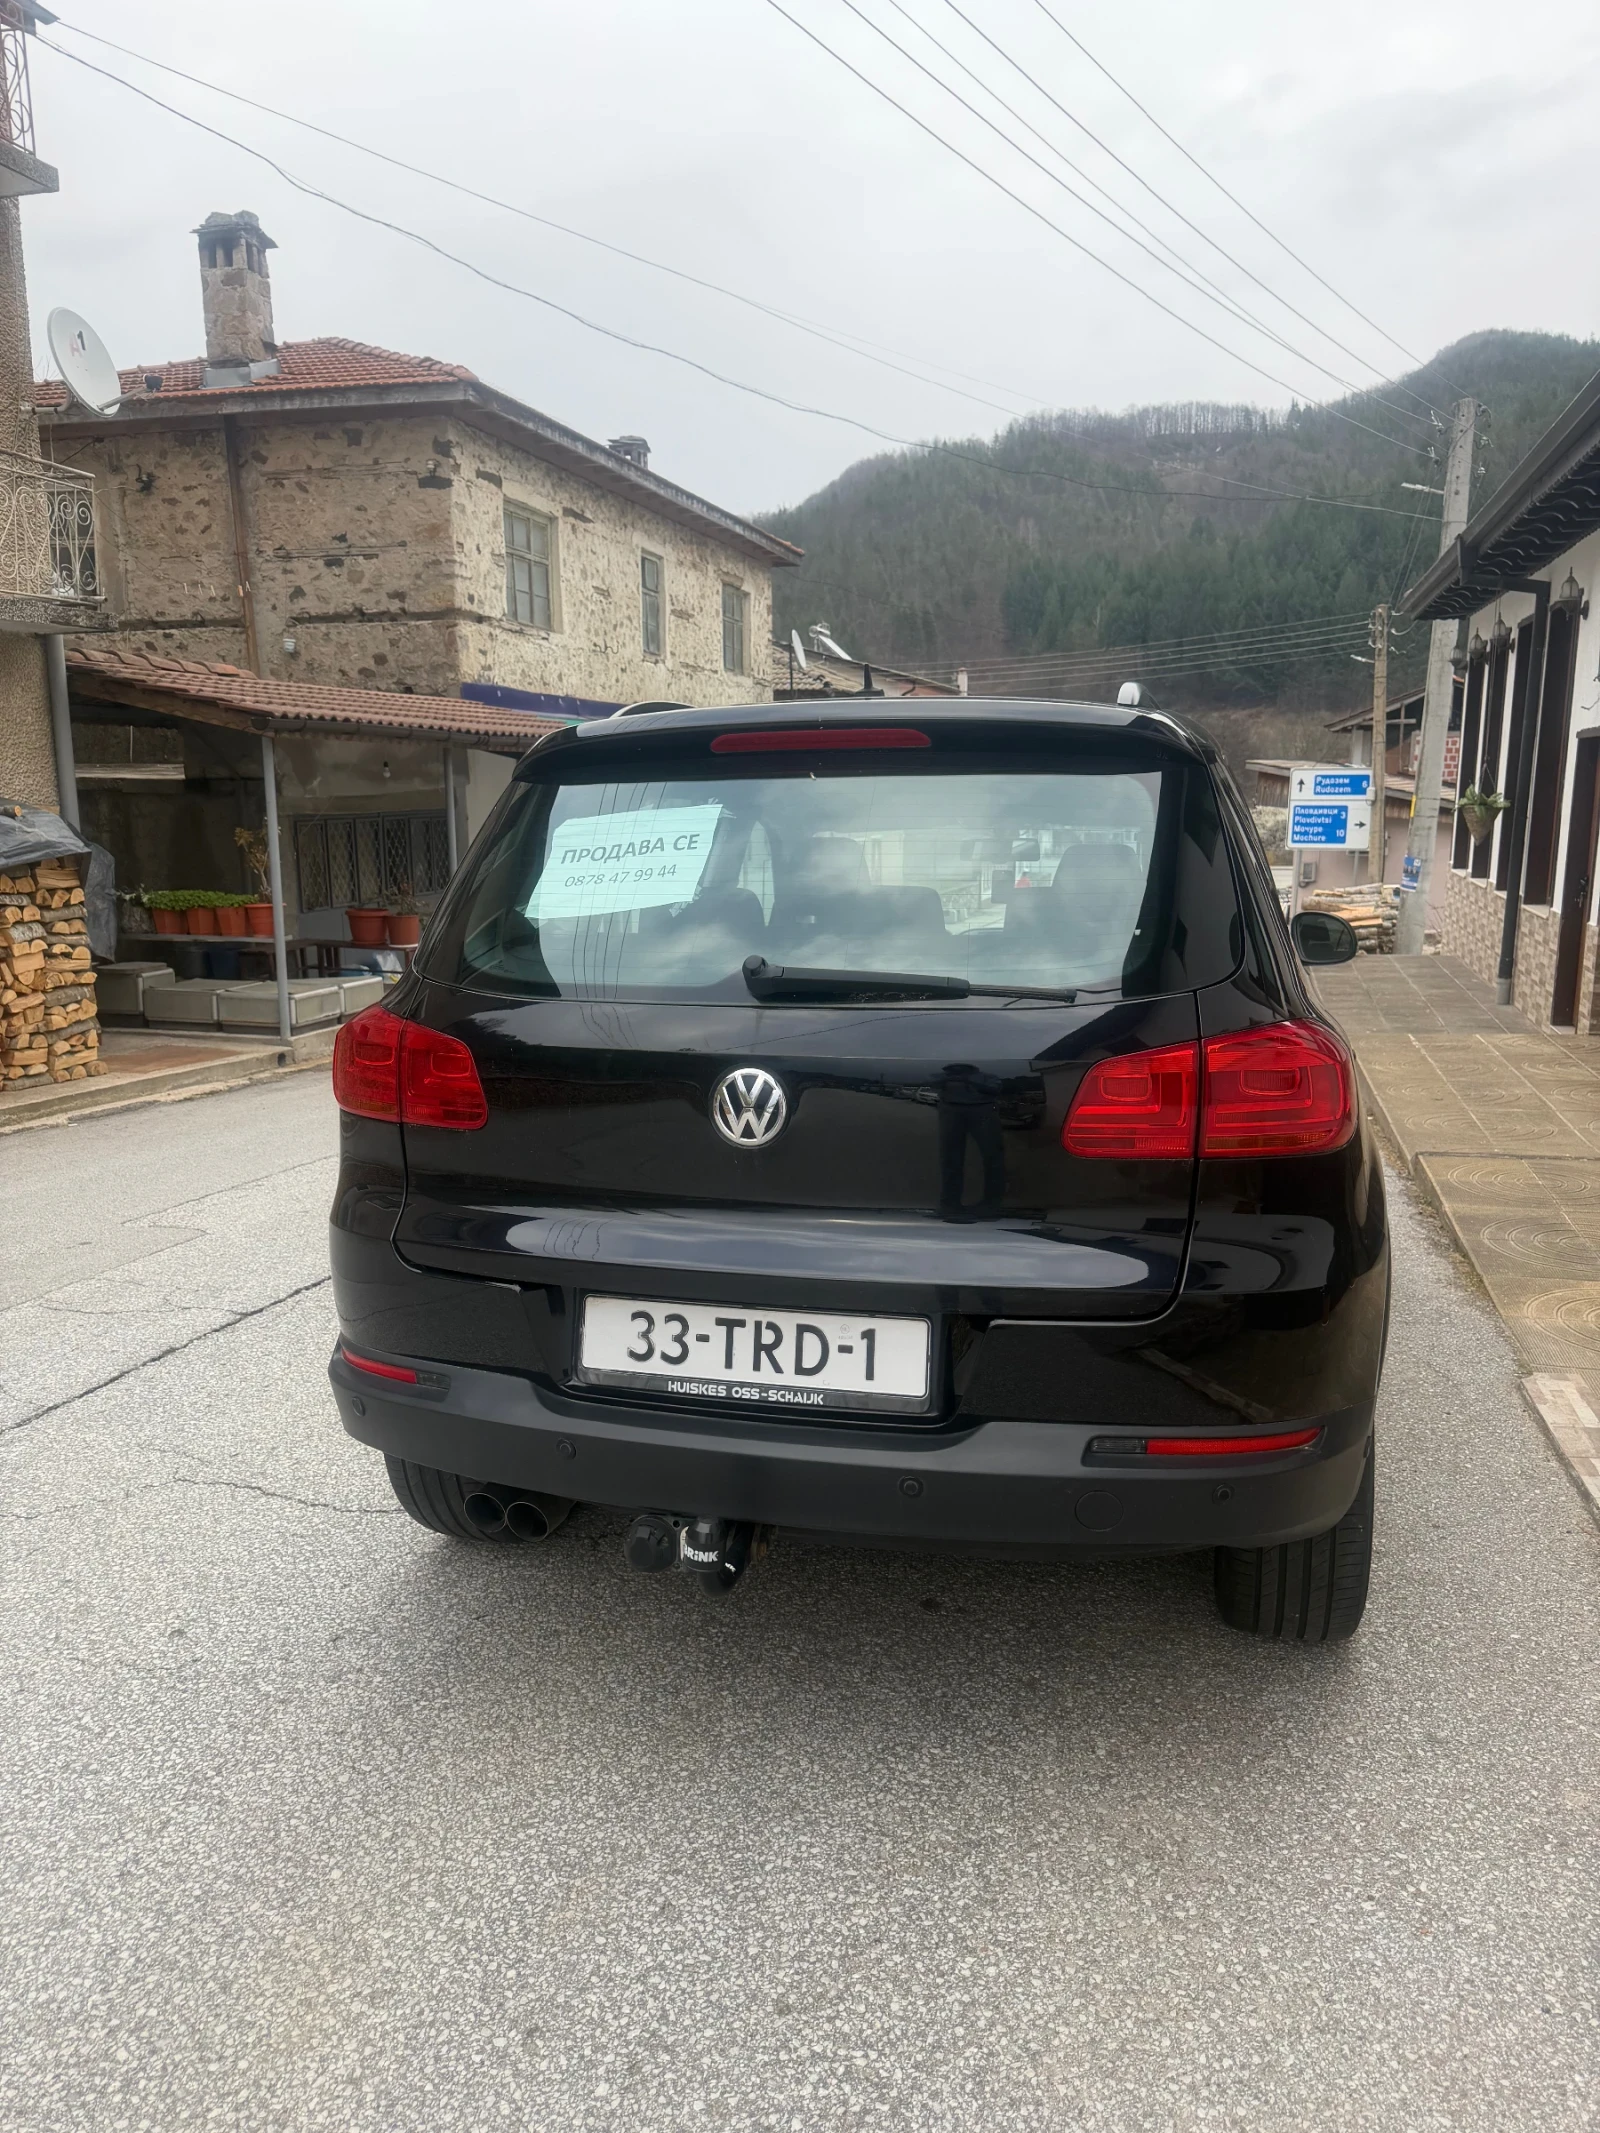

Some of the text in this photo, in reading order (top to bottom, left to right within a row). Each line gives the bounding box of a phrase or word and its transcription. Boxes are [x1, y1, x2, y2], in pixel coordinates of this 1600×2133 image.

[1316, 776, 1350, 785] Рудозем
[1295, 807, 1338, 815] Пловдивци
[1294, 816, 1332, 824] Plovdivtsi
[1293, 825, 1345, 837] Мочуре 10
[561, 834, 700, 864] ПРОДАВА СЕ
[564, 864, 677, 887] 0878 47 99 44
[627, 1310, 876, 1381] 33-TRD-1
[668, 1381, 824, 1405] HUISKES OSS-SCHAIJK
